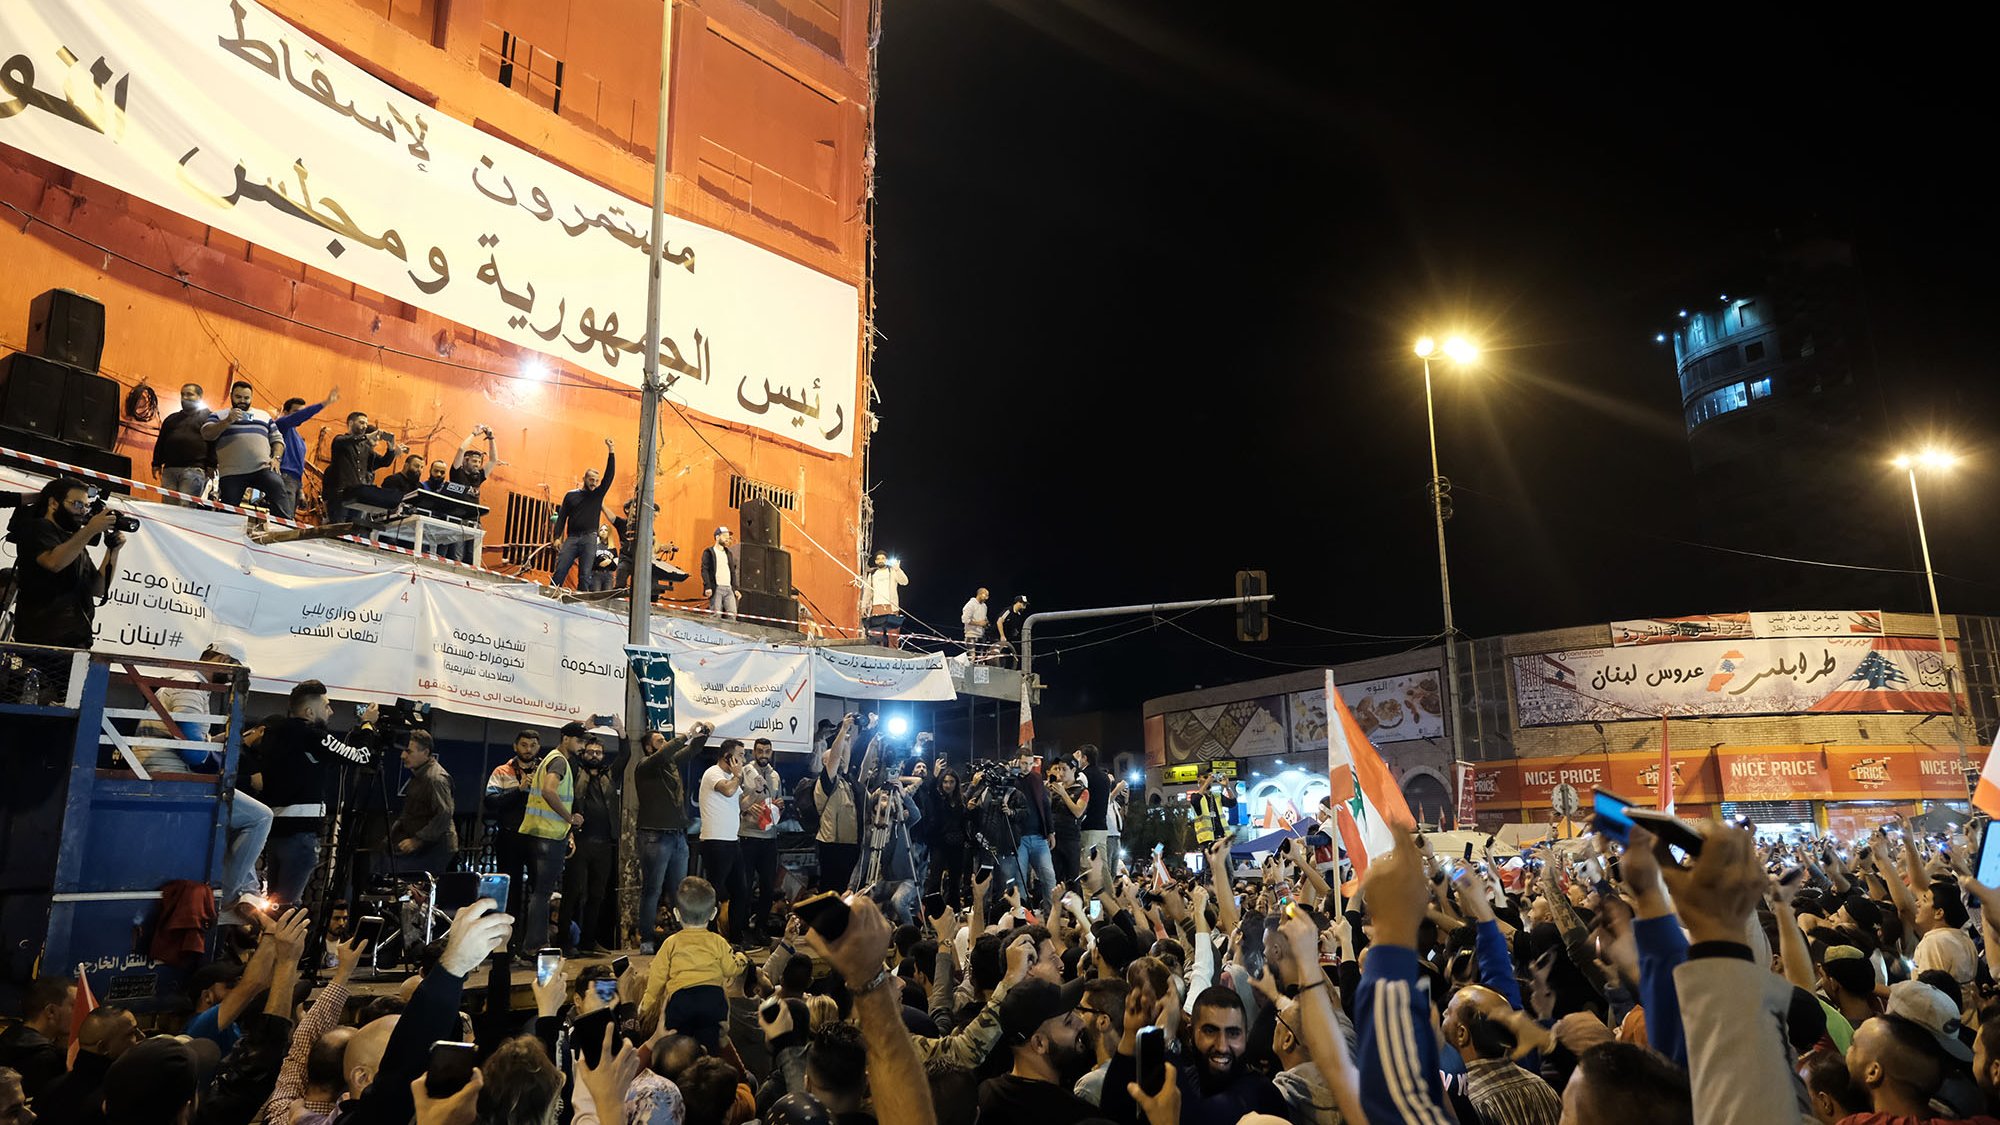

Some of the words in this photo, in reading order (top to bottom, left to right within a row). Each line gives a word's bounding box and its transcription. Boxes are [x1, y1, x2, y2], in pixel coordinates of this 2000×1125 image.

[218, 0, 430, 172] لإسقاط
[176, 146, 450, 295] ومجلس
[472, 155, 695, 274] مستمرون
[476, 233, 711, 386] الجمهورية
[737, 375, 843, 440] رئيس
[122, 569, 168, 588] موعد
[107, 589, 139, 606] النياب
[172, 578, 211, 602] إعلان
[400, 592, 409, 603] 4
[143, 594, 206, 620] الإنتخابات
[302, 603, 325, 619] يلبي
[325, 606, 356, 622] وزاري
[360, 609, 383, 625] بيان
[1812, 614, 1822, 622] من
[92, 621, 184, 650] #لبنان_ي
[290, 624, 334, 638] الشعب
[337, 627, 378, 643] تطلعات
[543, 622, 549, 634] 3
[453, 628, 491, 645] حكومة
[493, 637, 526, 652] تشكيل
[561, 655, 611, 678] الحكومة
[838, 656, 859, 668] ذات
[860, 657, 891, 672] مدنية
[1591, 664, 1637, 690] لبنان
[1646, 666, 1704, 687] عروس
[460, 686, 480, 698] حين
[701, 682, 724, 693] اللبناني
[726, 683, 752, 693] الشعب
[503, 694, 543, 709] الساحات
[545, 701, 567, 714] نترك
[721, 699, 727, 707] و
[728, 697, 760, 708] المناطق
[761, 697, 770, 707] كل
[770, 700, 781, 708] من
[569, 705, 580, 714] لن
[749, 718, 783, 732] طرابلس
[1731, 761, 1768, 777] NICE
[1770, 760, 1817, 776] PRICE
[1856, 766, 1884, 780] PRICE
[1920, 760, 1949, 775] NICE
[1525, 771, 1557, 786] NICE
[1560, 769, 1602, 785] PRICE
[1645, 771, 1676, 785] PRE
[1474, 780, 1496, 792] PRICE
[73, 955, 119, 978] الخارجي
[120, 954, 147, 971] للنقل
